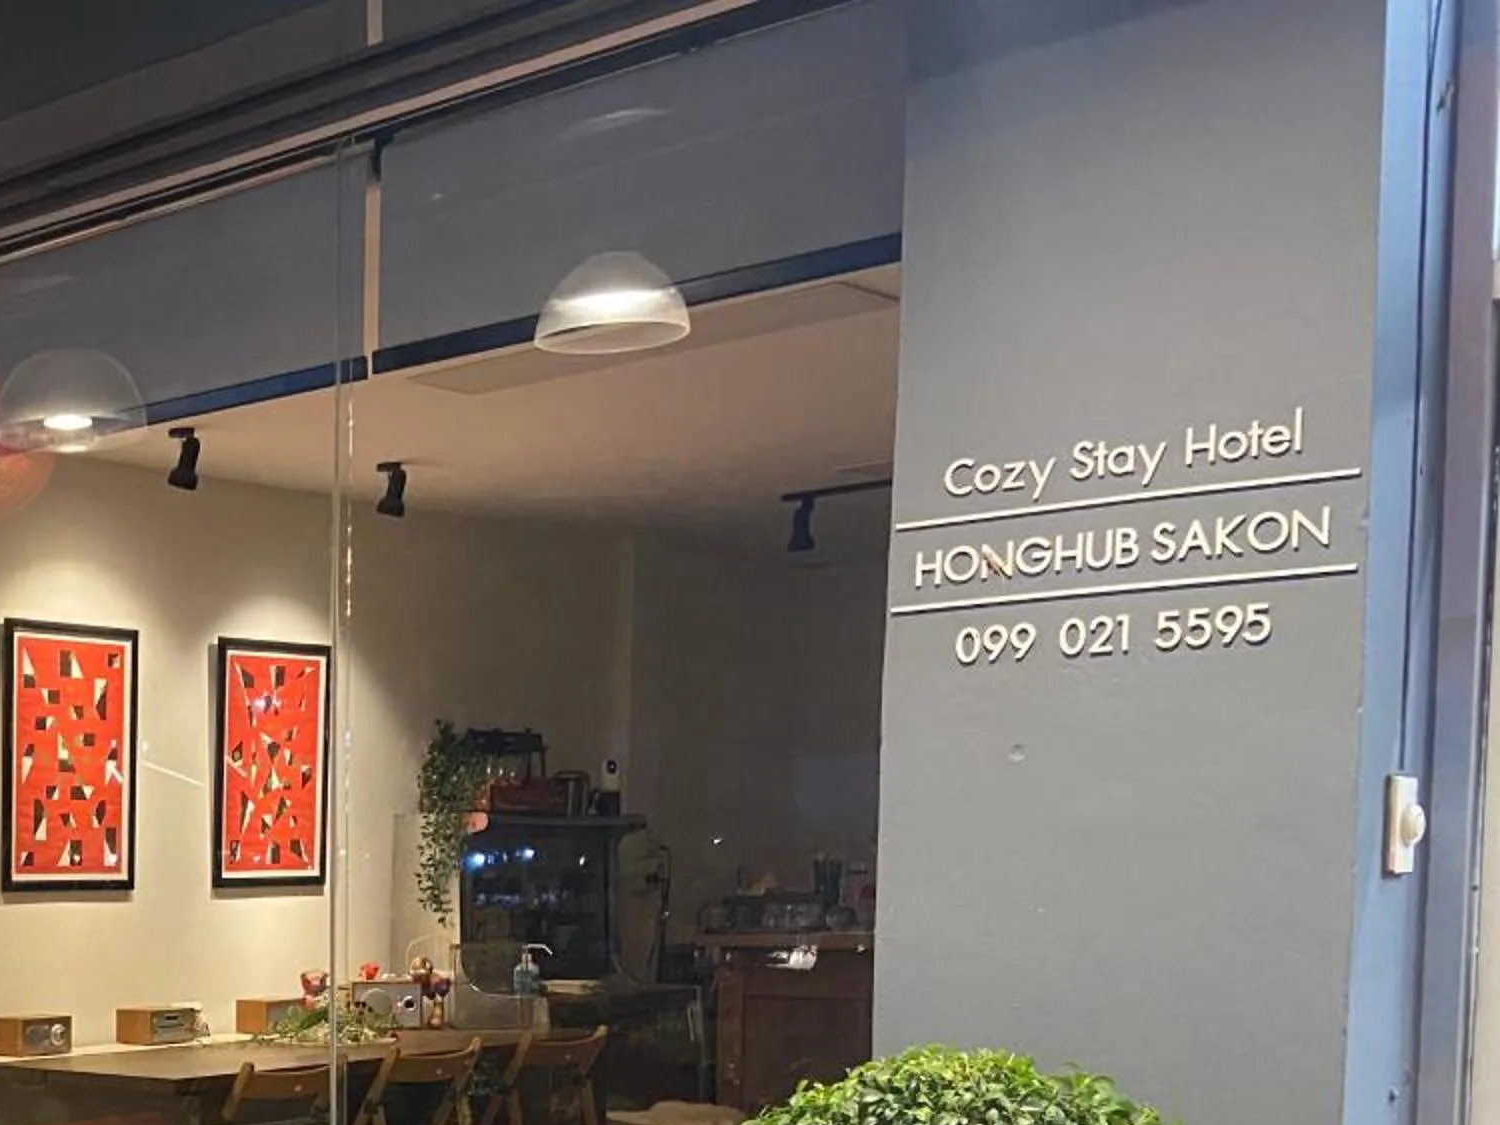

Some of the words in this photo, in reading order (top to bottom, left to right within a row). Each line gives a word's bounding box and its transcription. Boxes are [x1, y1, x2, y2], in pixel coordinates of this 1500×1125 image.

[944, 457, 1057, 499] Cozy
[1069, 440, 1167, 486] Stay
[1184, 407, 1303, 465] Hotel
[914, 527, 1139, 586] HONGHUB
[1151, 507, 1330, 562] SAKON
[955, 622, 1036, 664] 099
[1059, 614, 1130, 656] 021
[1154, 602, 1272, 649] 5595
